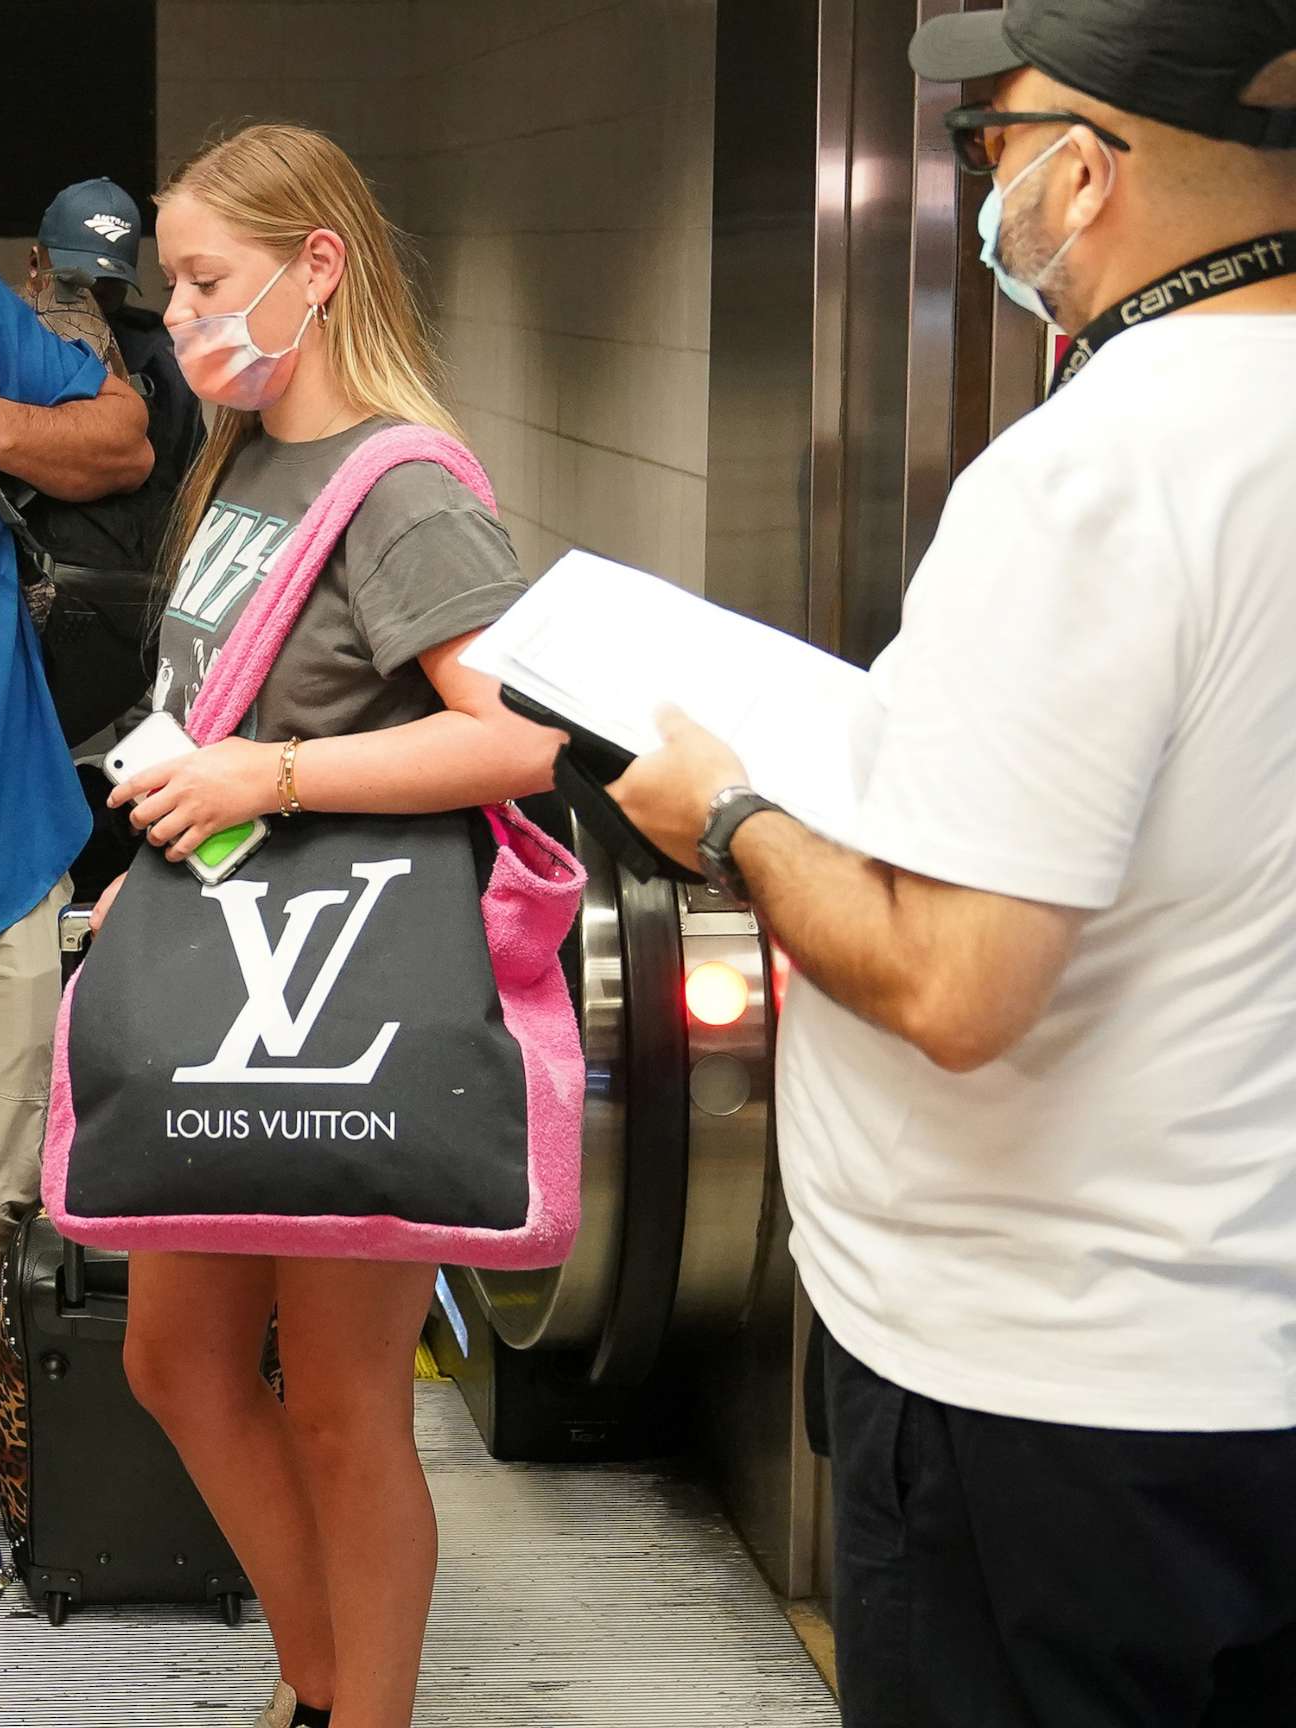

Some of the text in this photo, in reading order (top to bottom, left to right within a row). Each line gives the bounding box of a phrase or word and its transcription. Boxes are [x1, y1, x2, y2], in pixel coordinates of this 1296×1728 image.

[1120, 238, 1284, 326] carhartt
[166, 1109, 396, 1140] LOUIS VUITTON
